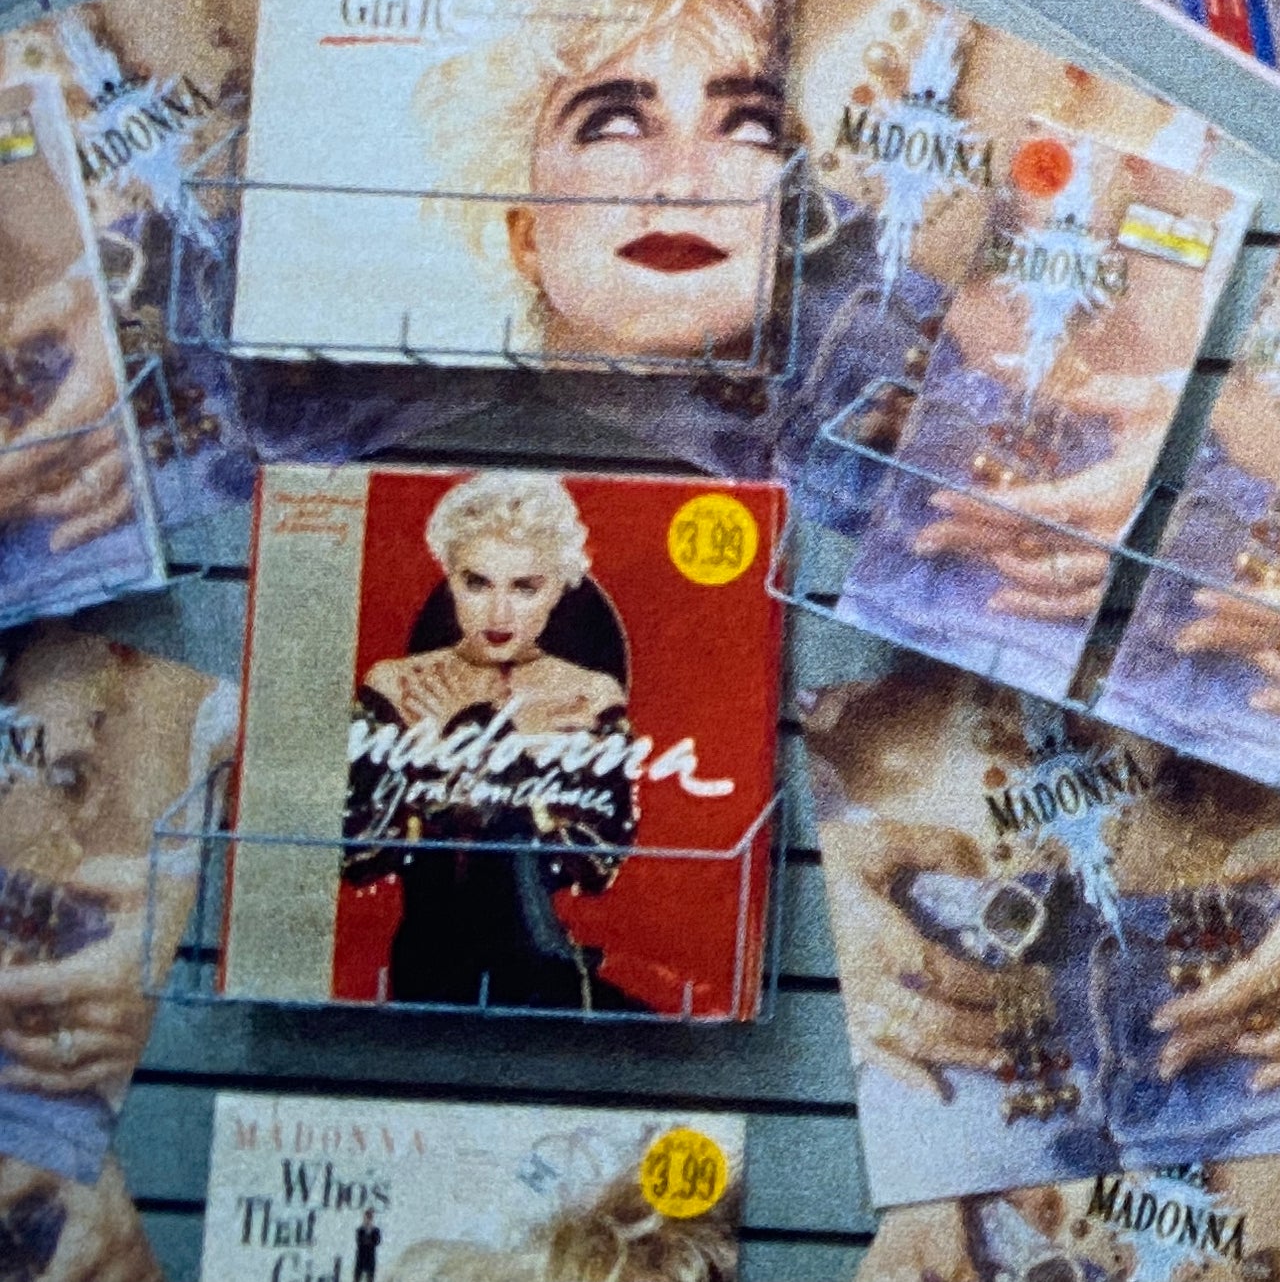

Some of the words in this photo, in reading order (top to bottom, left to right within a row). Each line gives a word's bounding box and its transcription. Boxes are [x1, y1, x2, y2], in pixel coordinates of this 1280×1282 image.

[836, 104, 994, 188] MADONNA
[983, 747, 1152, 835] MADONNA
[645, 1152, 719, 1201] 3.99
[1086, 1175, 1246, 1263] MADONNA
